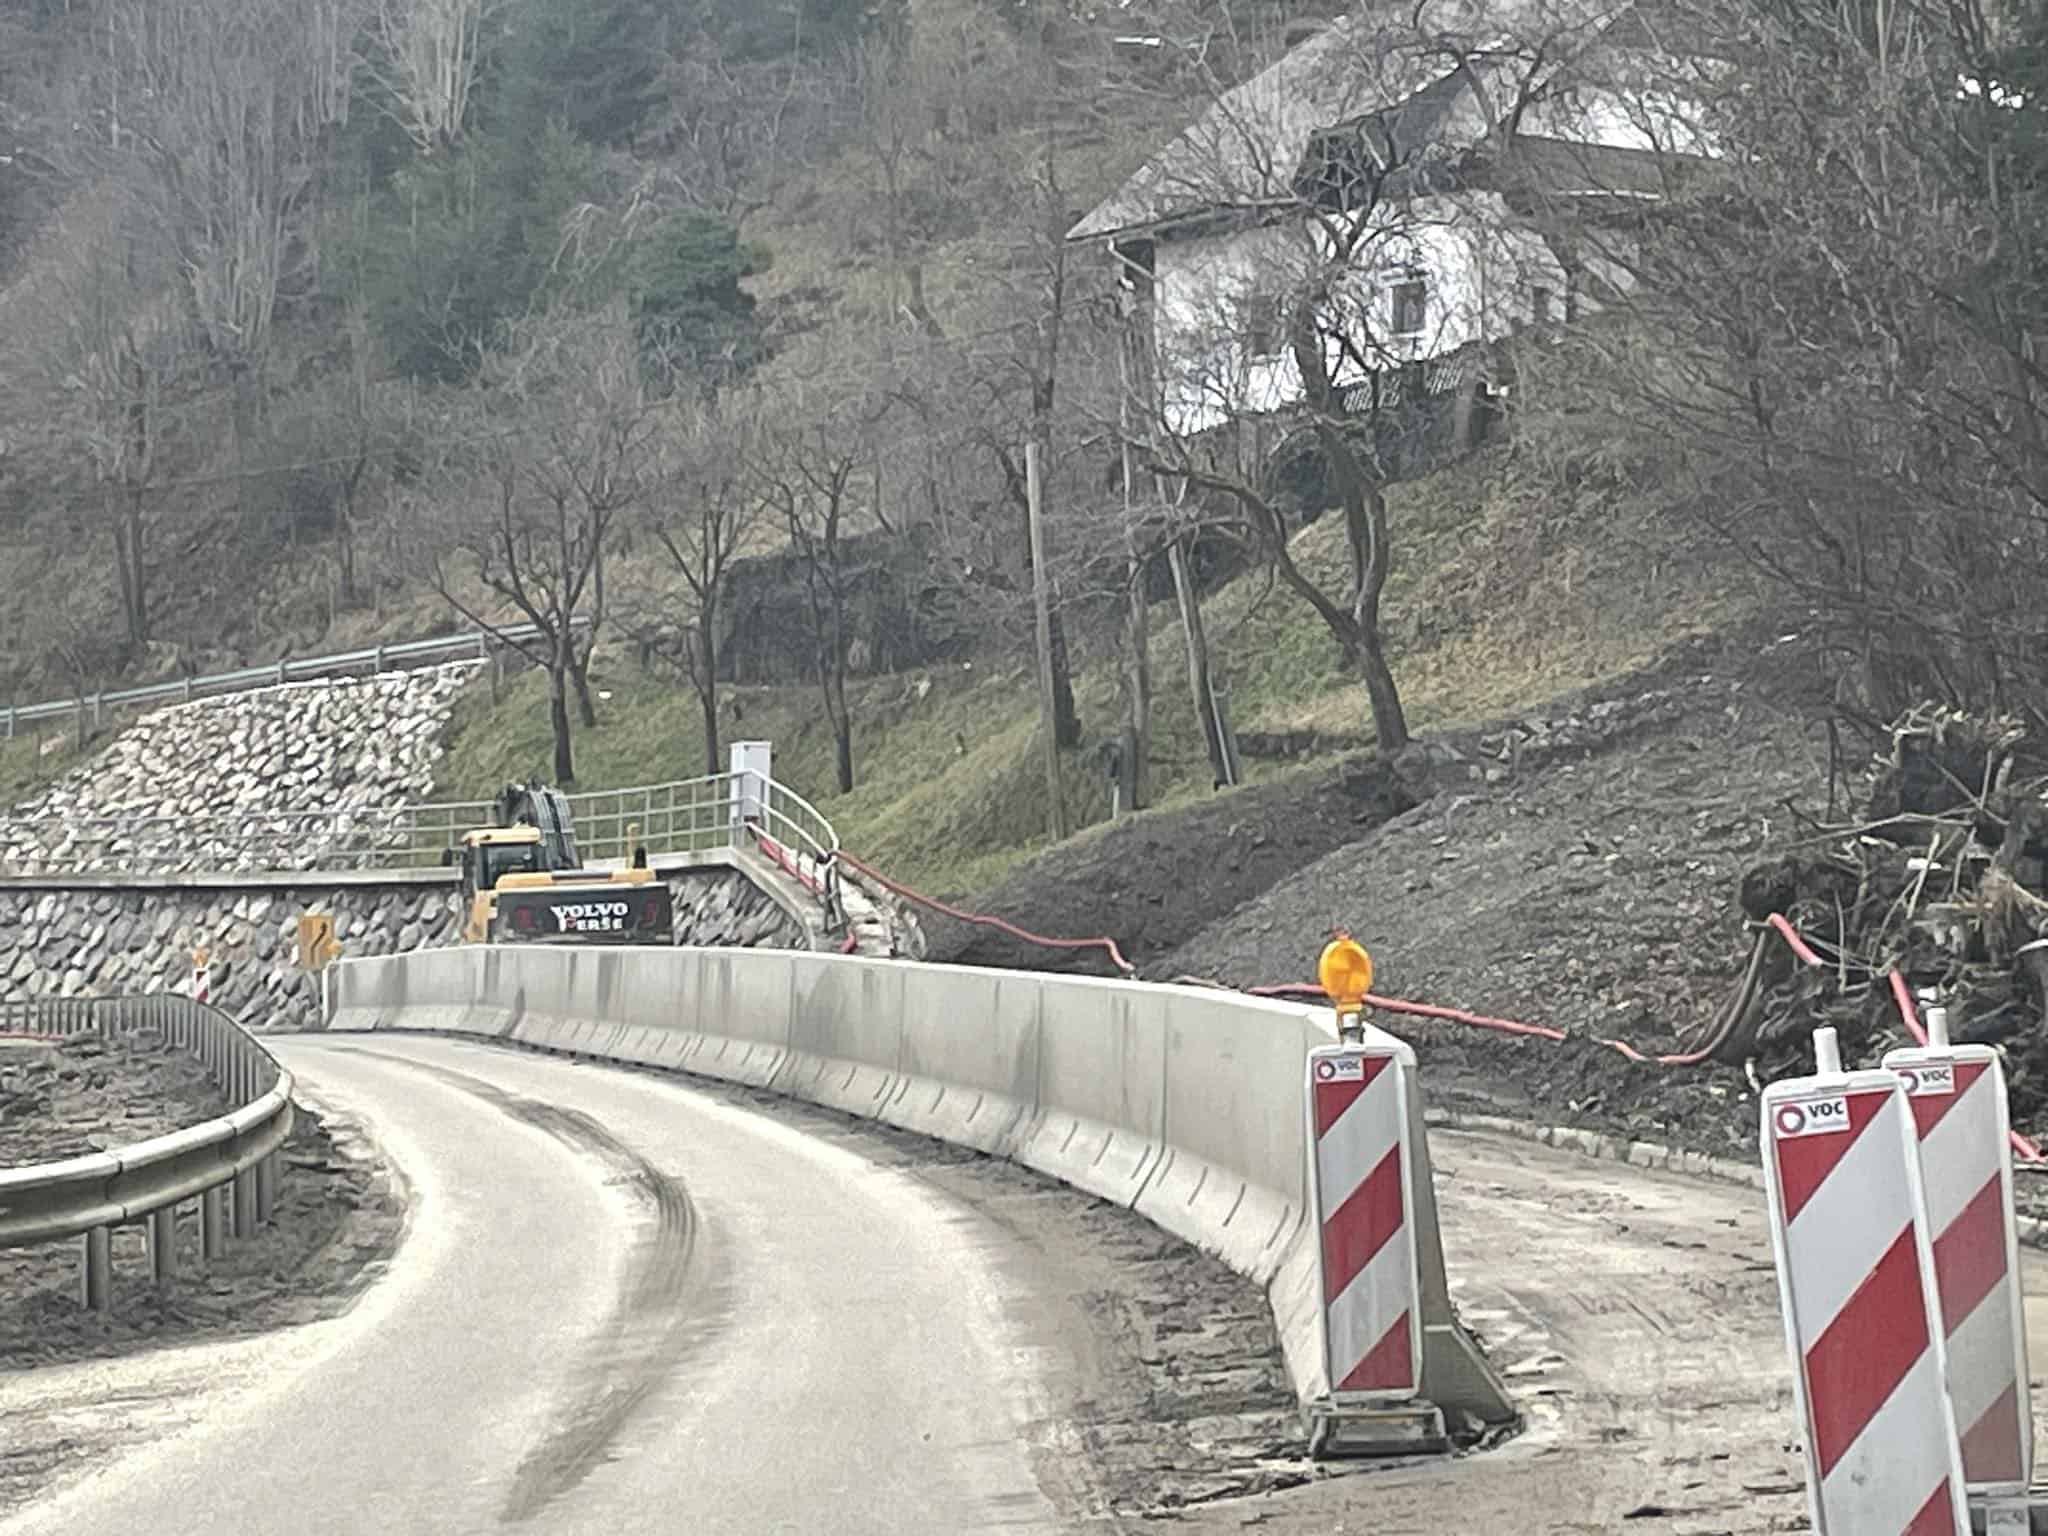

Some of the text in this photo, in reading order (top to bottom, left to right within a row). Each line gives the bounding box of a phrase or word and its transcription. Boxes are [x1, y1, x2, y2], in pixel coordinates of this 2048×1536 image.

[550, 902, 628, 918] VOLVO
[1921, 1069, 1950, 1083] VOC
[1808, 1101, 1845, 1118] VOC
